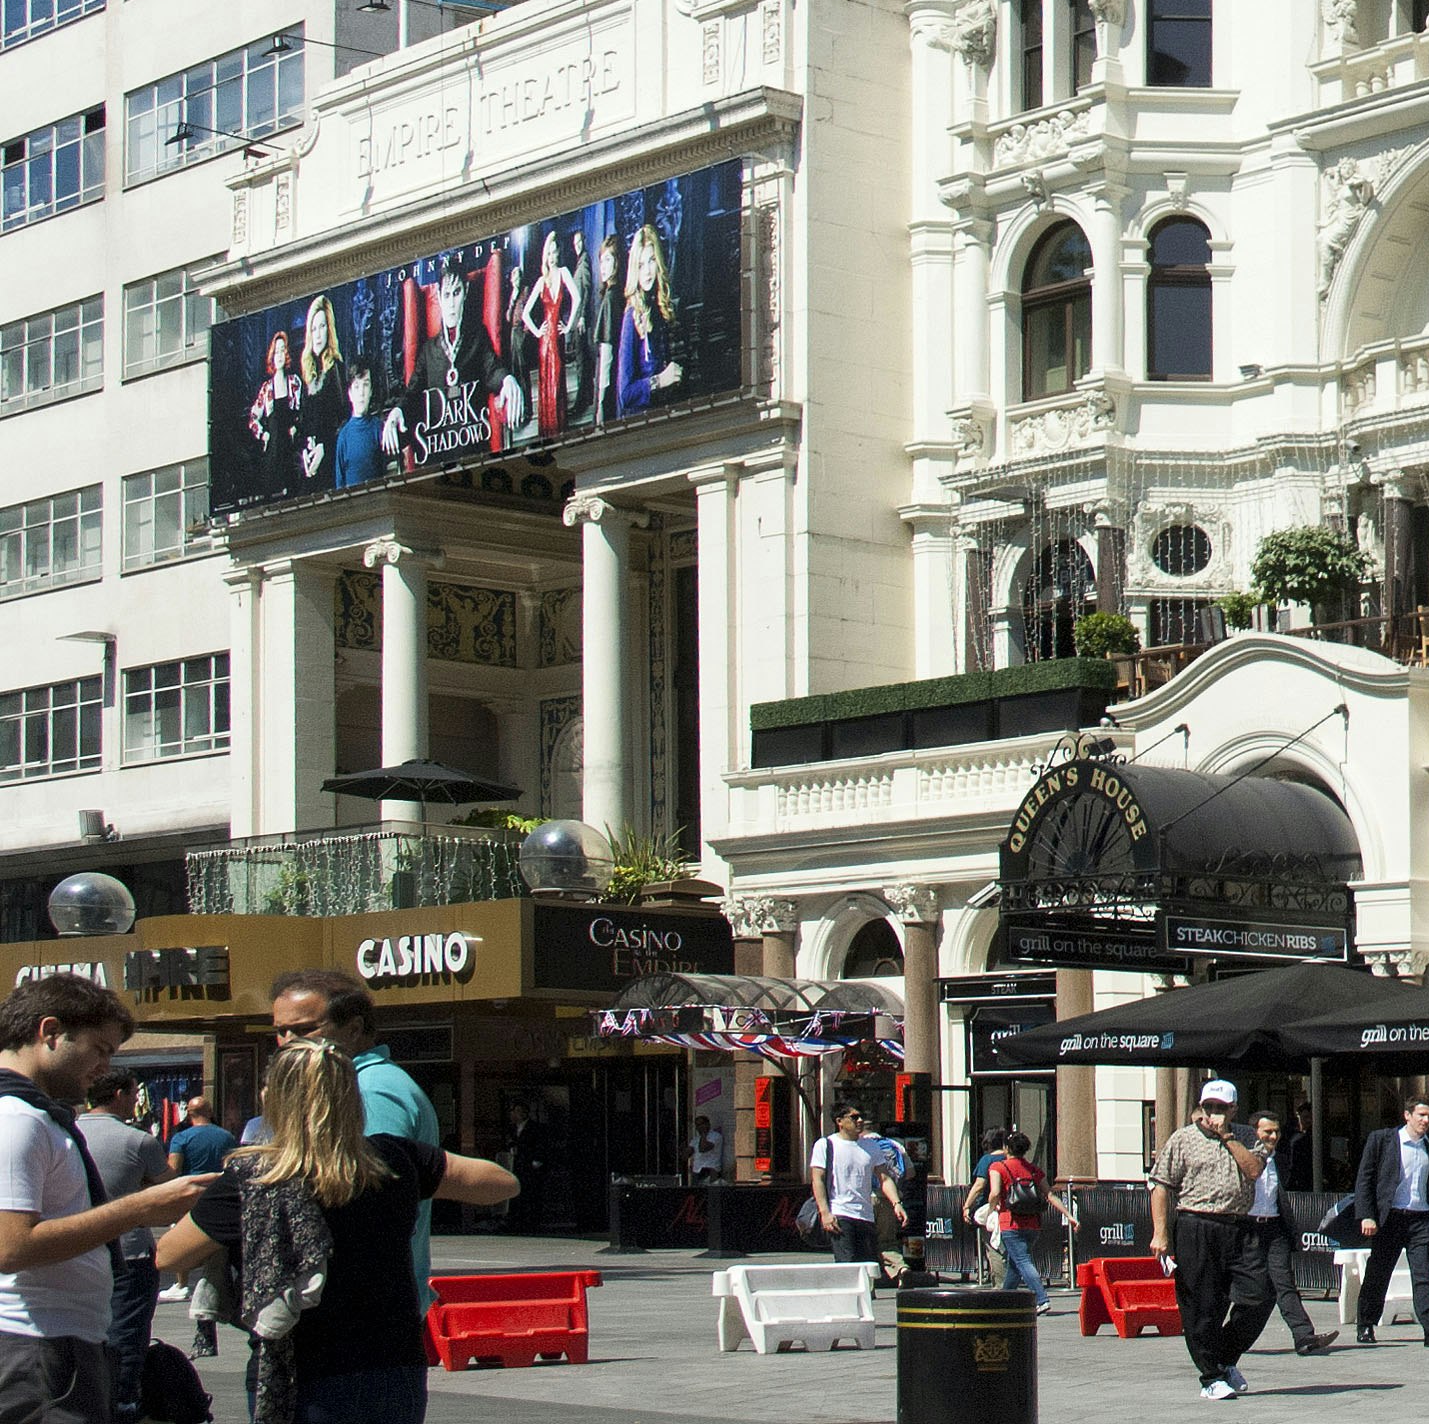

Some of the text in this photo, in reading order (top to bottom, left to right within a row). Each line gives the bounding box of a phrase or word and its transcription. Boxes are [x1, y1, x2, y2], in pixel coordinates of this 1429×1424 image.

[358, 50, 621, 178] EMPIRE THEATRE
[386, 236, 511, 287] JOHNNY DEP
[1010, 767, 1150, 854] QUEEN'S HOUSE
[356, 931, 470, 978] CASINO
[1019, 935, 1156, 960] grill on the square
[991, 983, 1017, 995] STEAK
[1059, 1032, 1159, 1056] grill on the square
[1360, 1024, 1388, 1048] grill
[1389, 1027, 1407, 1041] on
[1409, 1023, 1429, 1041] the
[926, 1218, 944, 1239] grill
[1100, 1223, 1123, 1245] grill
